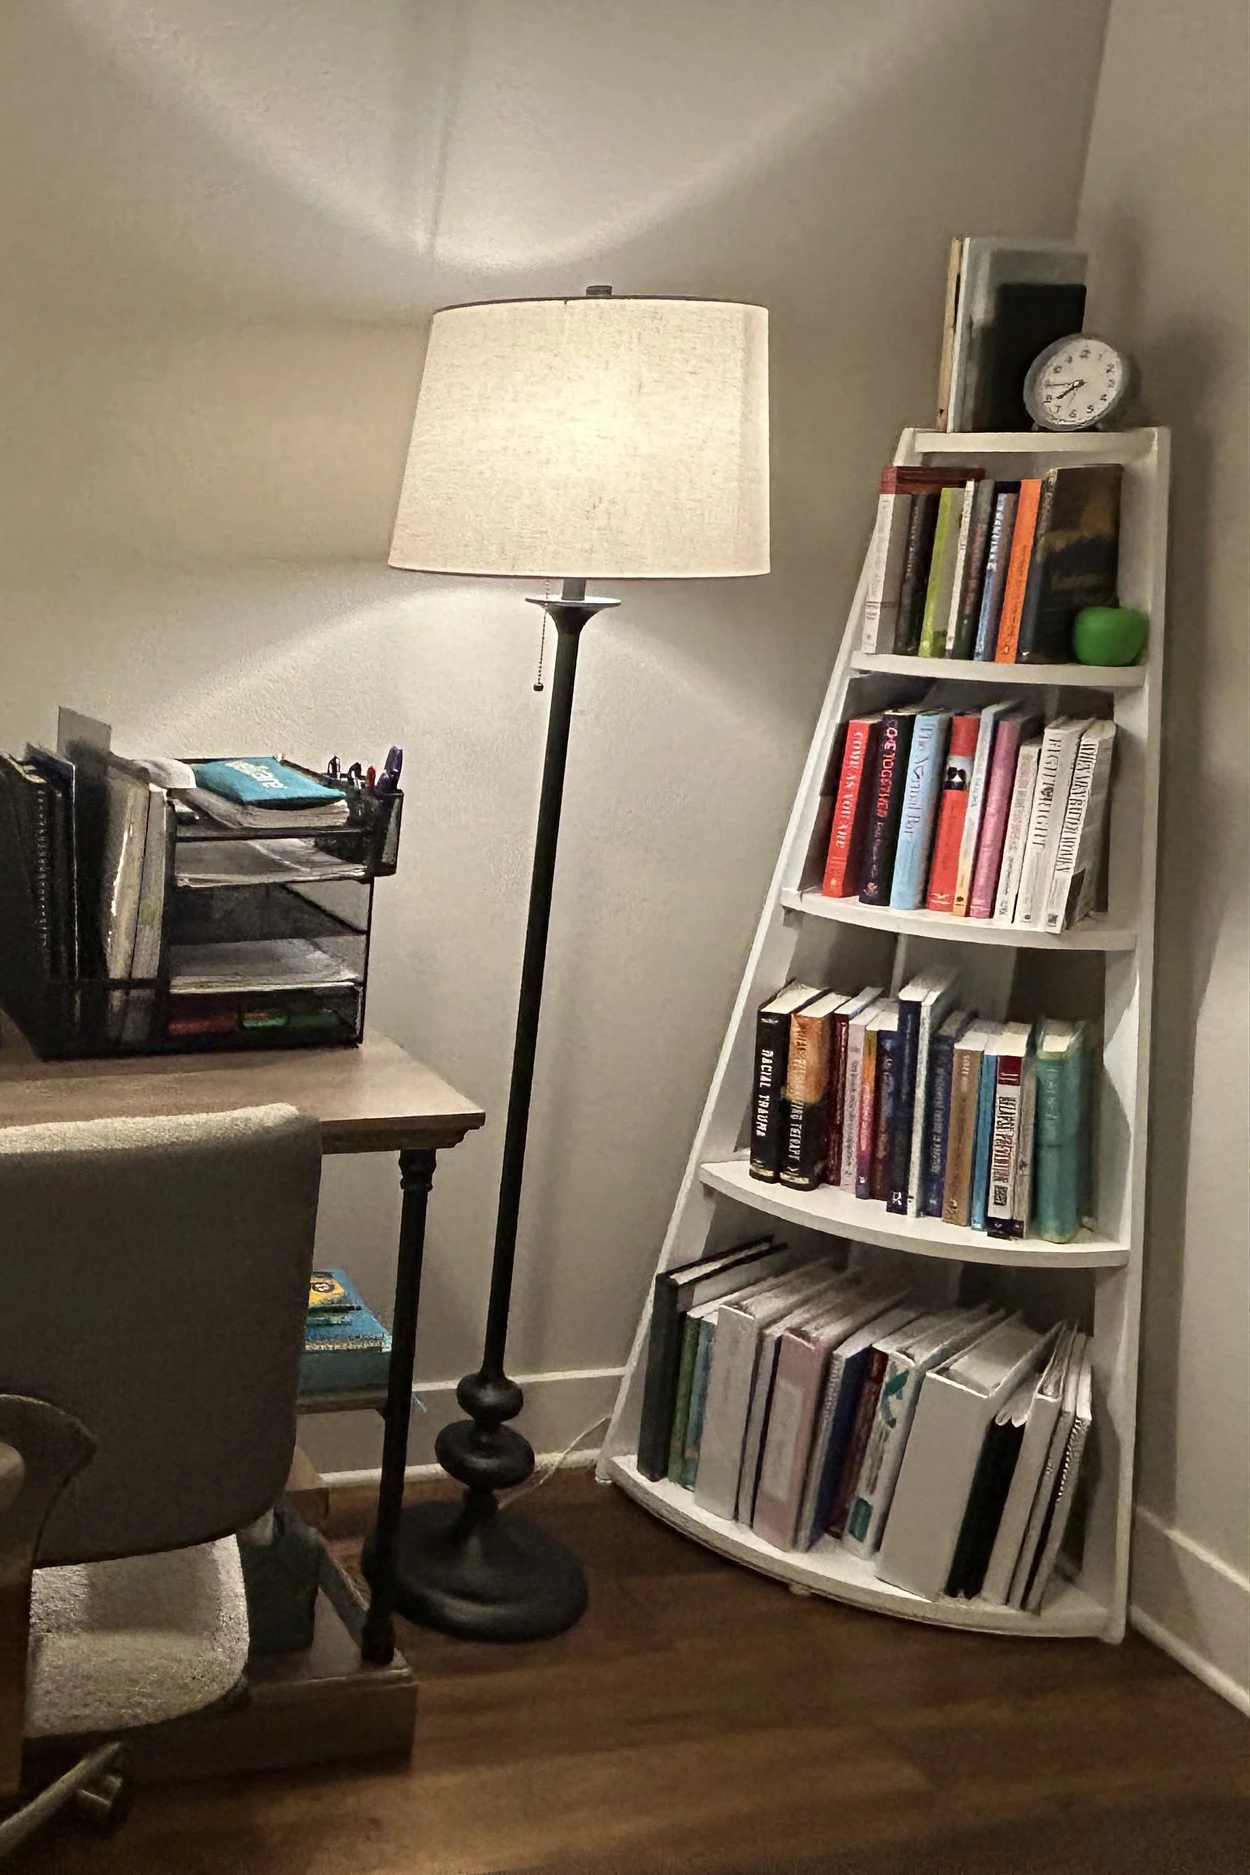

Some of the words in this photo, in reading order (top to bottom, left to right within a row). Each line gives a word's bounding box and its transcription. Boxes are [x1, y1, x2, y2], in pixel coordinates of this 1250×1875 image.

[848, 731, 863, 767] COME
[845, 773, 856, 788] AS
[878, 752, 896, 816] TOGETHER
[840, 792, 854, 818] YOU
[835, 823, 849, 848] ARE
[903, 814, 921, 837] Bar
[758, 1048, 773, 1088] RACIAL
[755, 1094, 769, 1136] TRAUMA
